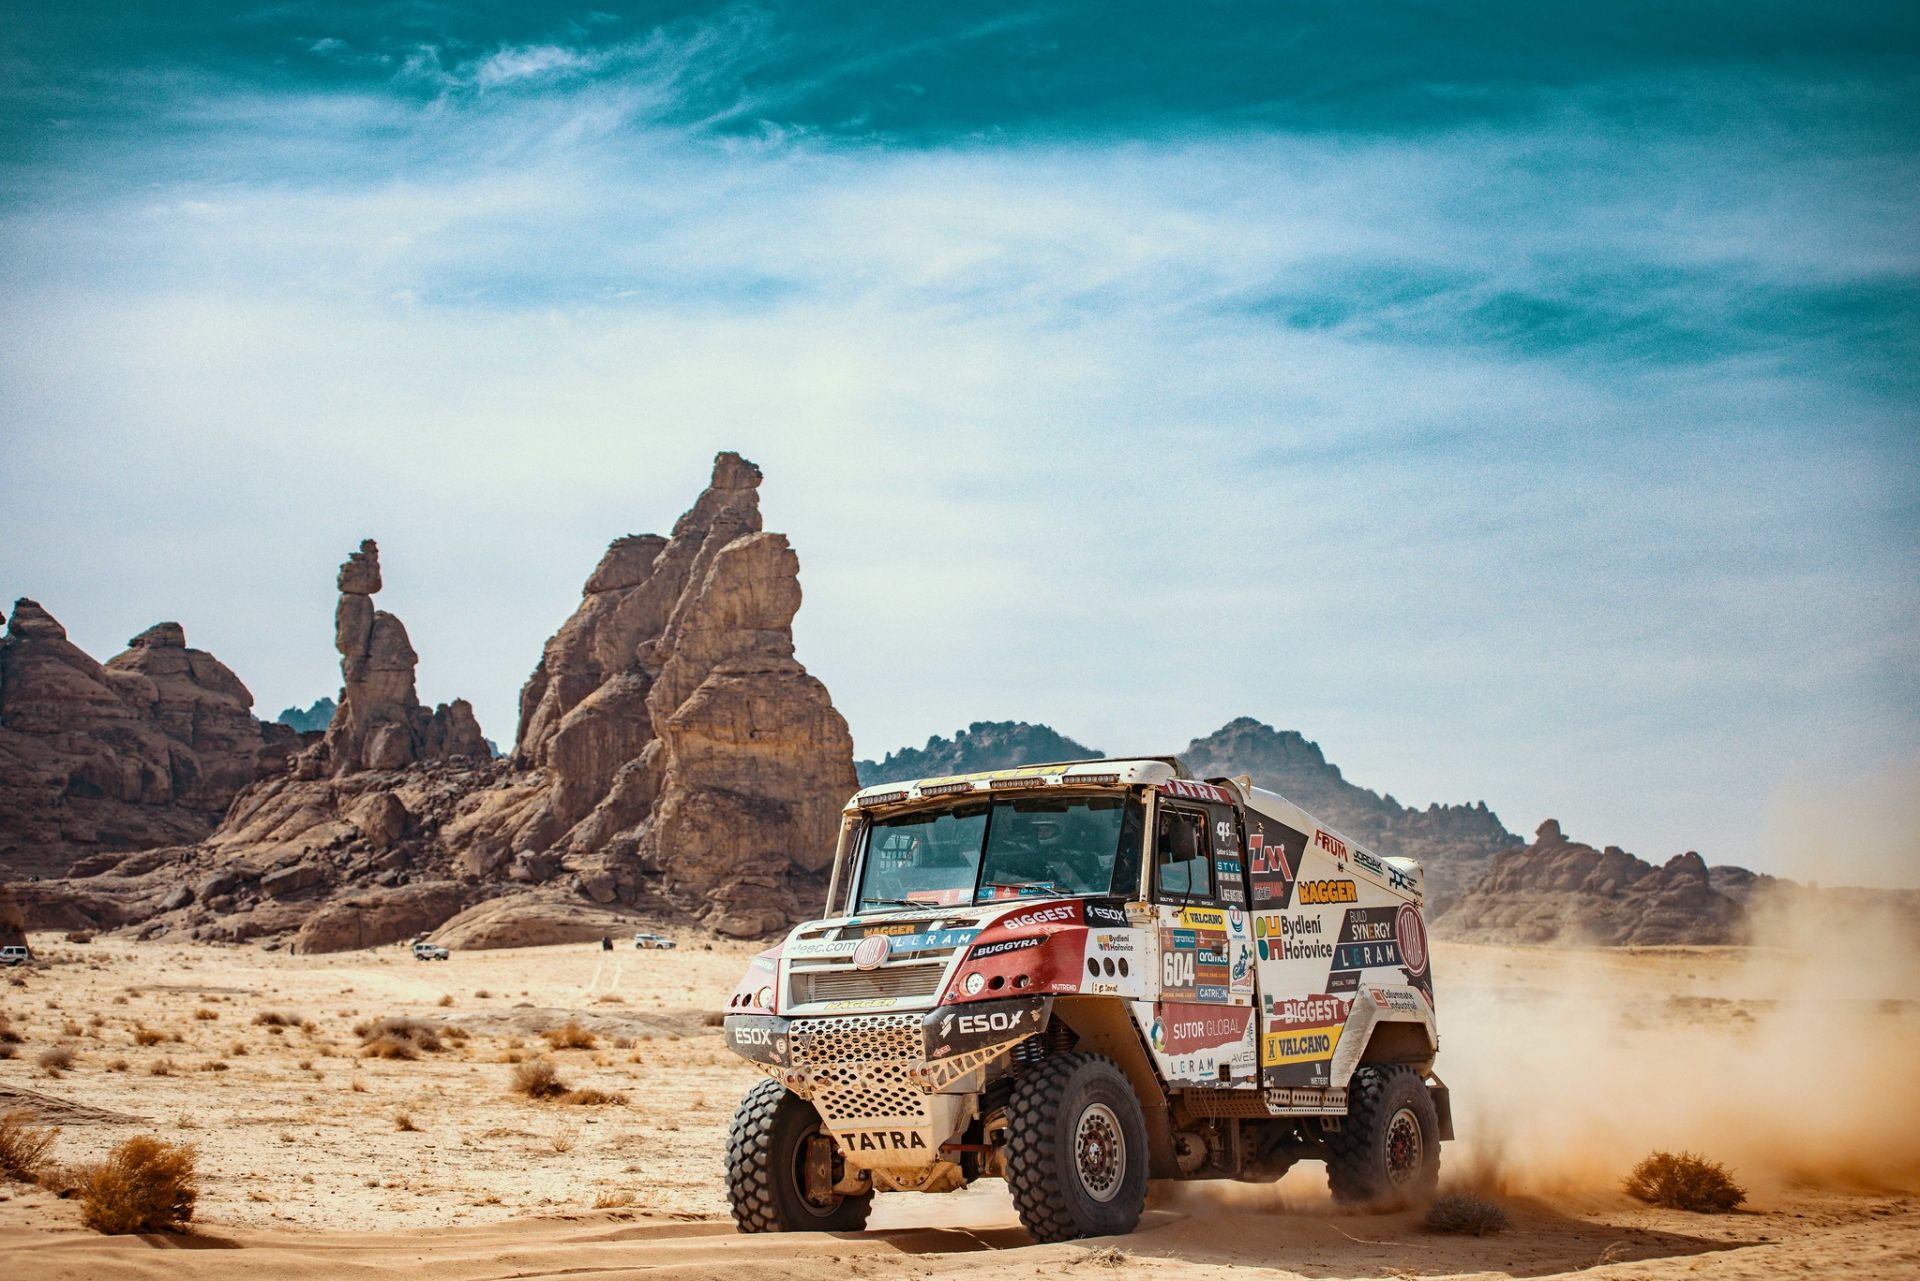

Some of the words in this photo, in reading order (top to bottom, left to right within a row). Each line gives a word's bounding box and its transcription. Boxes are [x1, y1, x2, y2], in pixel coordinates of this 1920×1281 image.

[1165, 779, 1224, 802] TATRA
[1314, 829, 1348, 862] FRUM
[1218, 861, 1240, 872] STYL
[1003, 905, 1076, 930] BIGGEST
[1095, 908, 1125, 922] ESOX
[1190, 912, 1223, 925] VALCANO
[1350, 910, 1367, 923] BUILD
[1281, 914, 1322, 940] Bydlení
[1352, 922, 1391, 941] SYNERGY
[977, 938, 1039, 957] BUGGYRA
[1284, 938, 1333, 960] Hořovice
[1163, 952, 1195, 987] 604
[1051, 983, 1077, 992] NUTREND
[958, 1010, 1024, 1034] ESOX
[1284, 1000, 1339, 1024] BIGGEST
[735, 1028, 772, 1045] ESOX
[1173, 1021, 1204, 1040] SUTOR
[1206, 1018, 1241, 1036] GLOBAL
[1278, 1034, 1330, 1056] VALCANO
[841, 1130, 927, 1152] TATRA
